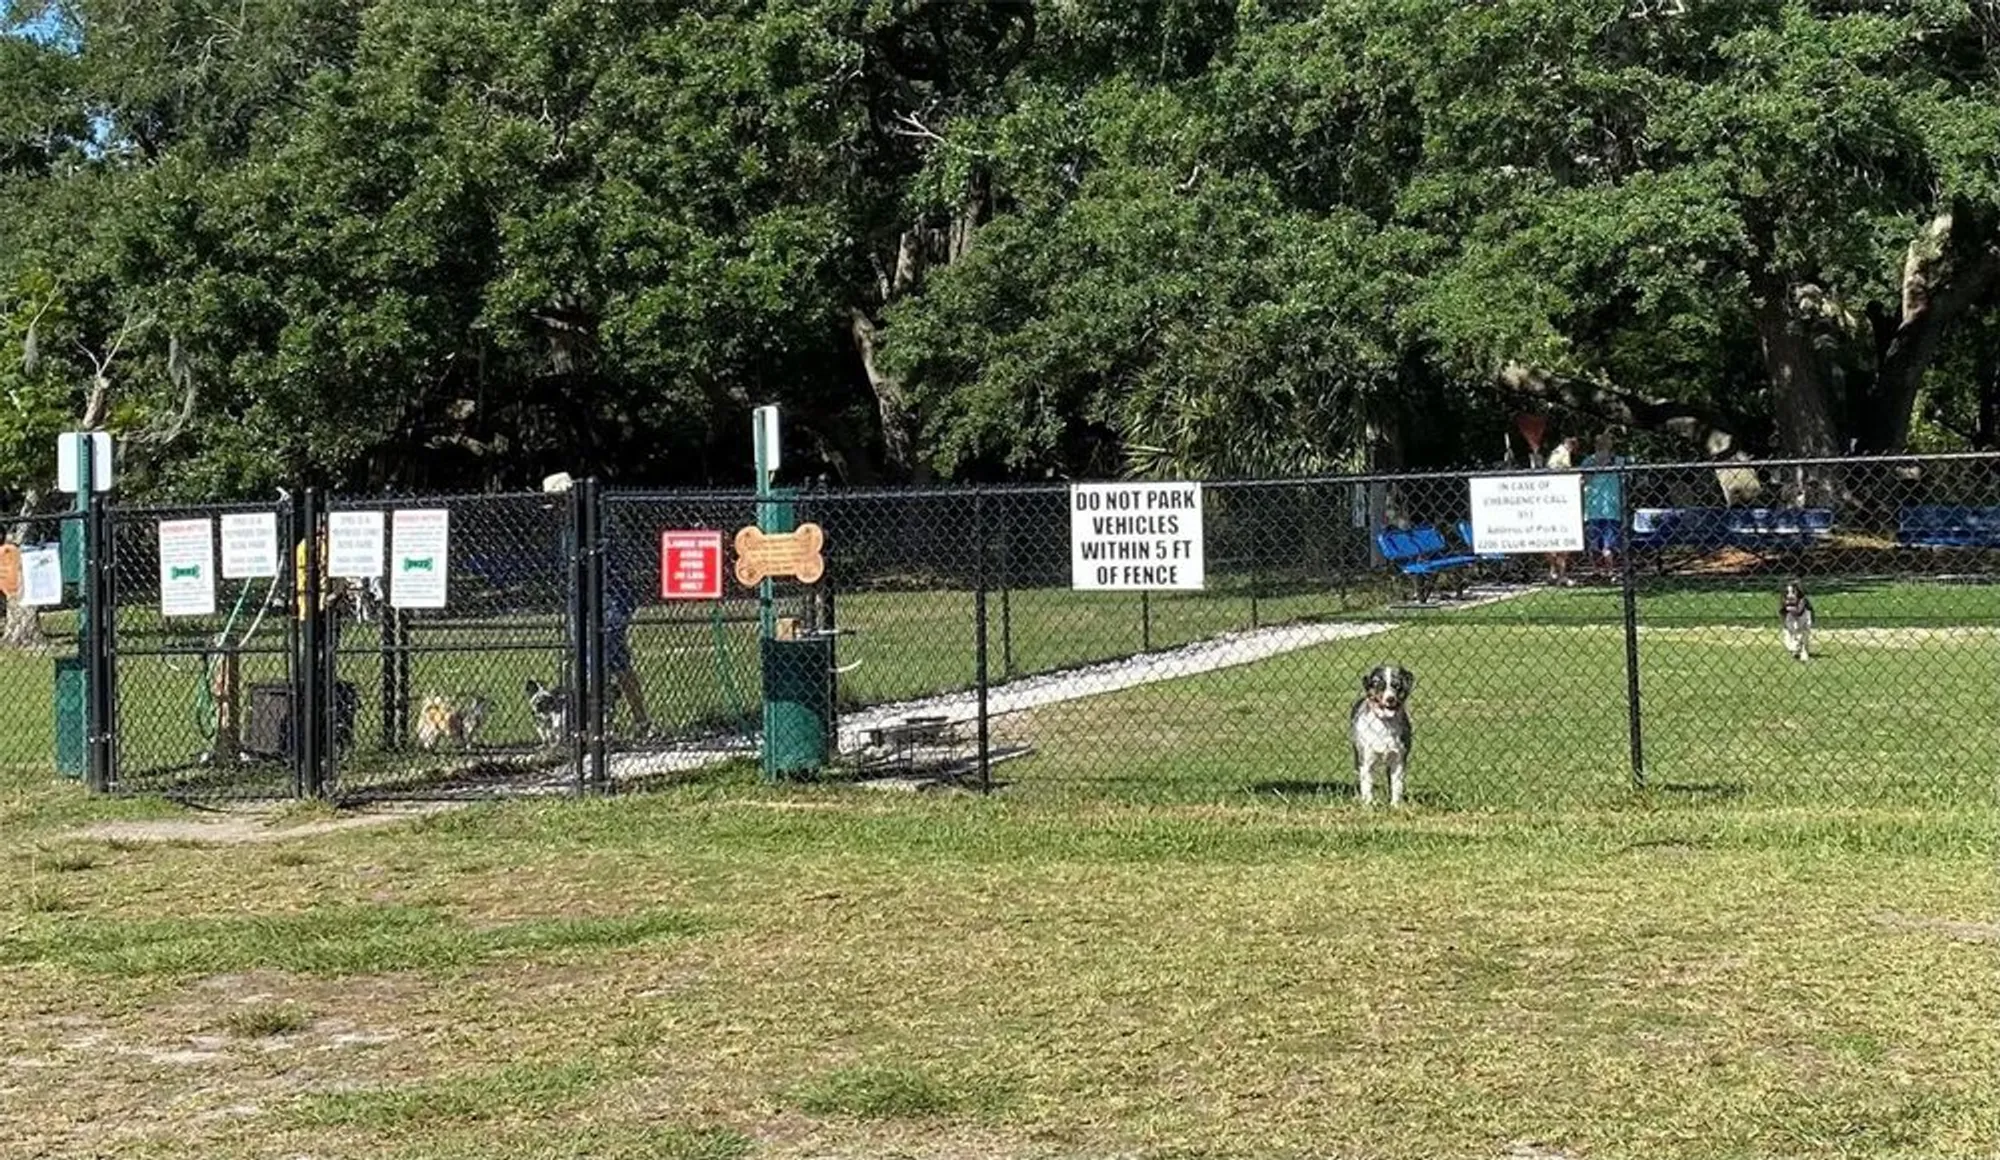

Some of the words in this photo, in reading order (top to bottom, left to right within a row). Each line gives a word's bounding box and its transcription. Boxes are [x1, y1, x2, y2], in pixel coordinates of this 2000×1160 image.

[1511, 481, 1535, 491] CASE
[1538, 480, 1550, 490] OF
[1076, 491, 1100, 511] DO
[1106, 490, 1141, 510] NOT
[1147, 489, 1195, 509] PARK
[1483, 495, 1540, 506] EMERGENCY
[1543, 494, 1568, 504] CALL
[1092, 514, 1179, 535] VEHICLES
[1536, 524, 1557, 533] Park
[1081, 540, 1149, 560] WITHIN
[1156, 540, 1167, 560] 5
[1173, 540, 1192, 559] FT
[1528, 538, 1560, 548] HOUSE
[1097, 565, 1118, 585] OF
[1124, 565, 1178, 585] FENCE
